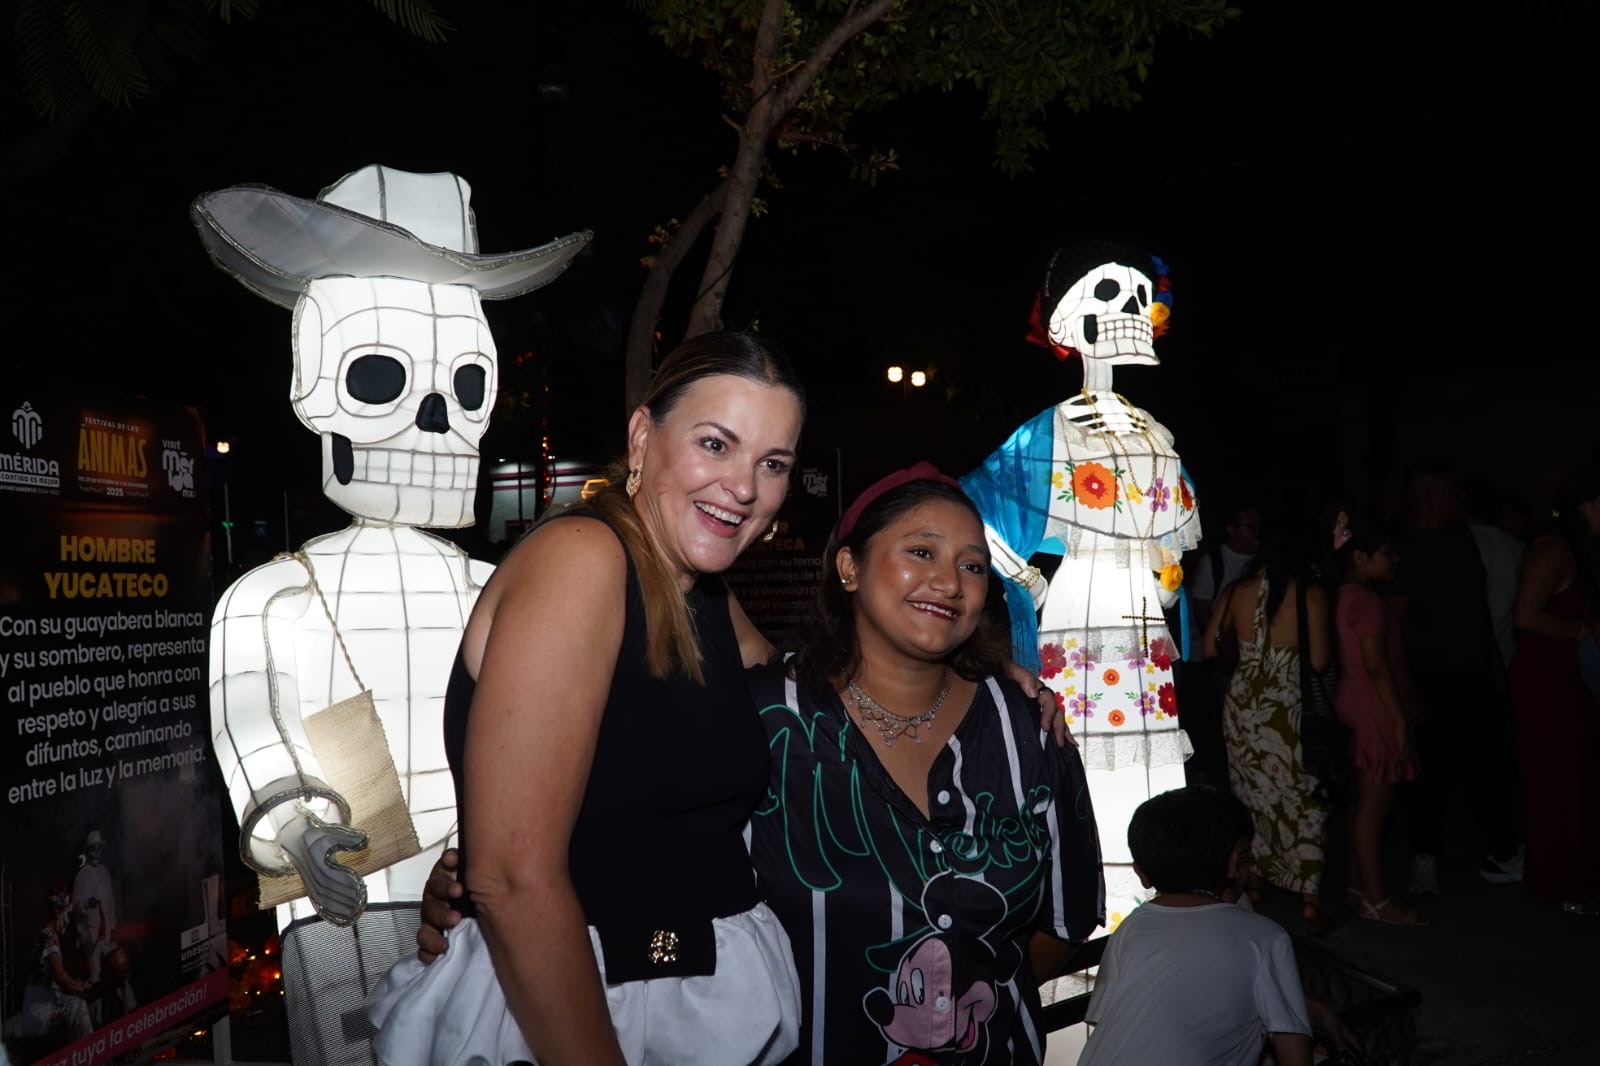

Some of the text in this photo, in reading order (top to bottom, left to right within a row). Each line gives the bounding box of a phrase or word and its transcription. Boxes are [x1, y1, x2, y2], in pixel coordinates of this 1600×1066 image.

[0, 452, 60, 476] MÉRIDA
[77, 423, 148, 479] ÁNIMAS
[0, 473, 29, 482] CONTIGO
[106, 487, 124, 496] 2025
[59, 534, 157, 564] HOMBRE
[44, 572, 169, 599] YUCATECO
[0, 609, 204, 640] Con su guayabera blanca
[0, 637, 205, 678] y su sombrero, representa
[8, 666, 201, 707] al pueblo que honra con
[17, 694, 197, 738] respeto y alegría a sus
[25, 720, 192, 767] difuntos, caminando
[8, 745, 207, 805] entre la luz y la memoria.
[72, 983, 208, 1066] tuya la celebración!
